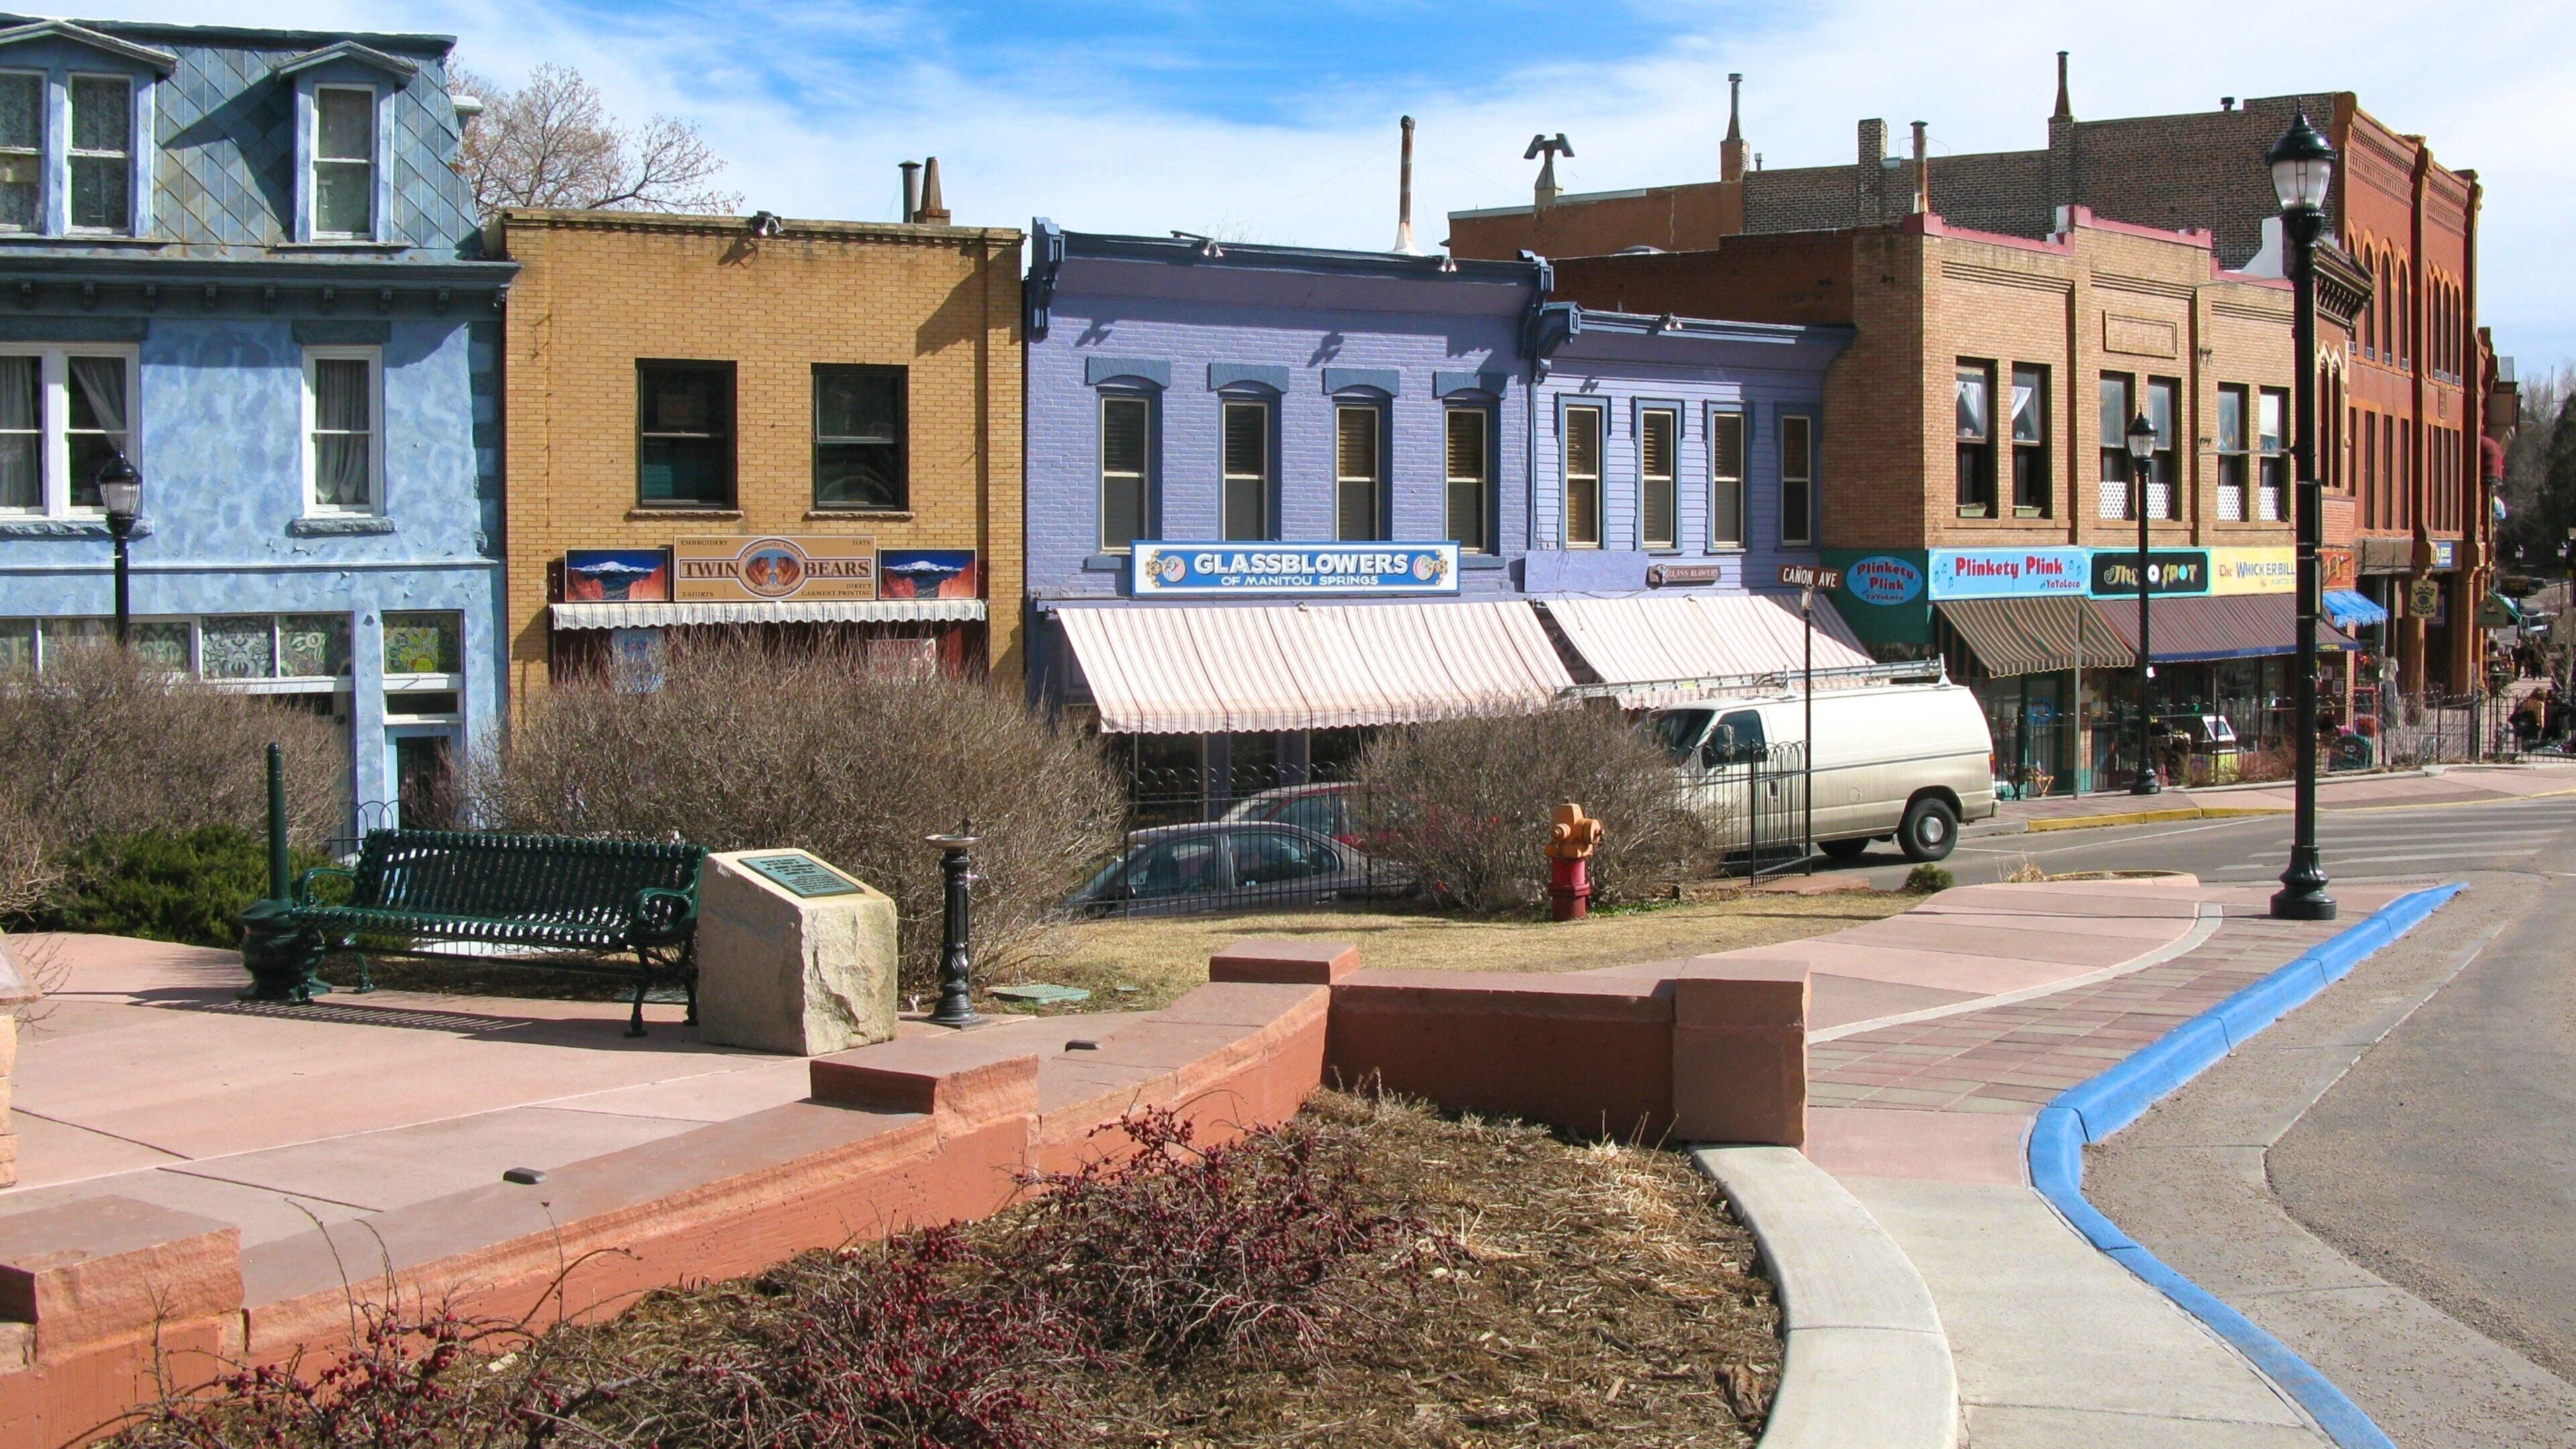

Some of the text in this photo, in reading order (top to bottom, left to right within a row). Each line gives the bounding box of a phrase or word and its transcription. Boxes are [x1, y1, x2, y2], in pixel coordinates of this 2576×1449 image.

[682, 561, 869, 576] TWIN BEARS
[1194, 553, 1409, 575] GLASSBLOWERS
[1856, 561, 1914, 580] Plinkety
[1955, 555, 2063, 579] Plinkety Plink
[1221, 576, 1379, 586] OF MANITOU SPRINGS
[1782, 566, 1837, 588] CAÑON AVE
[1869, 577, 1904, 590] Plink
